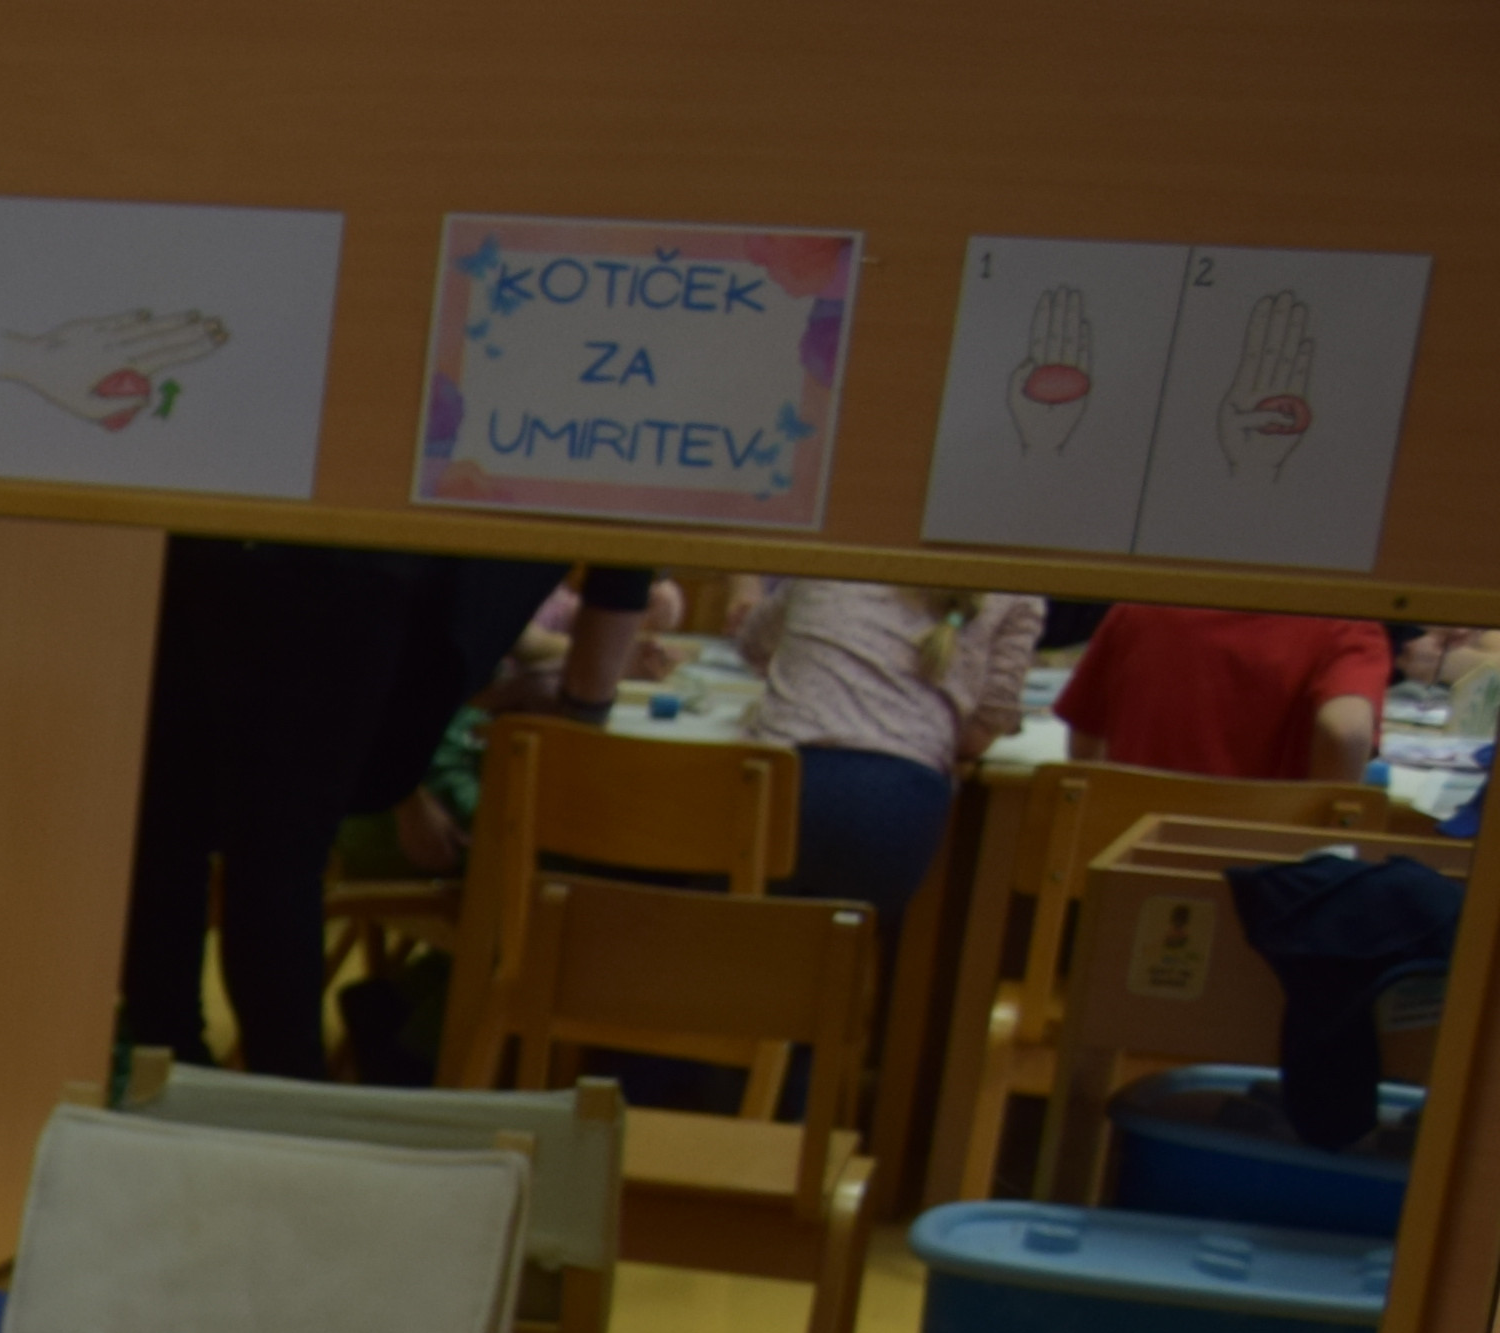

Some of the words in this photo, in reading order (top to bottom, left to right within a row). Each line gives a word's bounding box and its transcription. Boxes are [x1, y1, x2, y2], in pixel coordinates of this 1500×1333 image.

[494, 246, 766, 314] KOTIČEK
[978, 251, 993, 280] 1
[1193, 256, 1215, 287] 2
[578, 340, 656, 386] ZA
[488, 408, 765, 470] UMIRITEV
